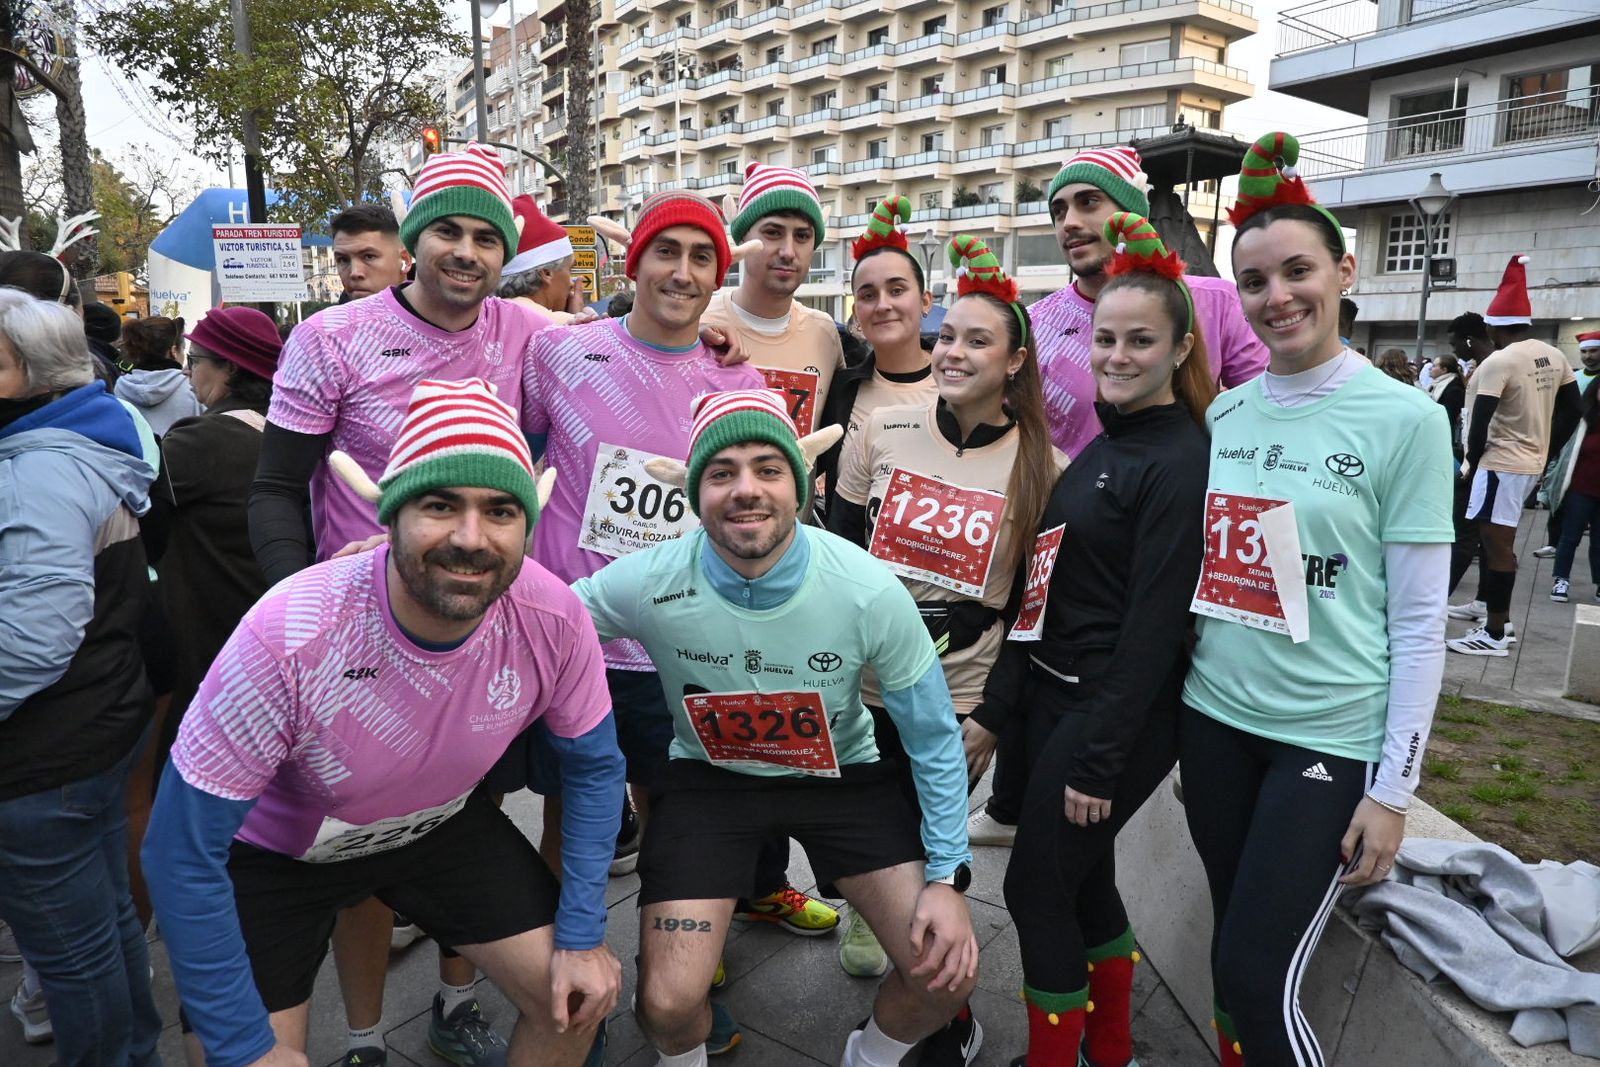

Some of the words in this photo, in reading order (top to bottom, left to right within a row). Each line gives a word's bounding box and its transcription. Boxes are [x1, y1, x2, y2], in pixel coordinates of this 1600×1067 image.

[216, 230, 243, 238] PARADA
[244, 230, 262, 238] TREN
[219, 242, 244, 251] VIZTOR
[286, 242, 297, 250] S.L.
[150, 290, 187, 301] Huelva
[382, 348, 410, 357] 42K
[584, 353, 610, 362] 42K
[1534, 356, 1550, 368] RUN
[884, 422, 910, 430] luanvi
[1216, 447, 1256, 460] Huelva
[1278, 462, 1308, 472] HUELVA
[1312, 478, 1359, 498] HUELVA
[610, 476, 686, 522] 306
[1214, 496, 1228, 506] 5K
[892, 490, 993, 546] 1236
[632, 520, 658, 529] CARLOS
[600, 522, 640, 540] ROVIRA
[922, 535, 944, 546] ELENA
[895, 536, 940, 554] RODRIGUEZ
[941, 548, 967, 562] PEREZ
[1248, 568, 1274, 579] TATIANA
[1214, 572, 1256, 587] BEDARONA
[1258, 581, 1270, 591] DE
[653, 590, 685, 606] luanvi
[676, 648, 728, 666] Huelva
[344, 668, 379, 680] 42K
[763, 667, 794, 676] HUELVA
[804, 676, 844, 688] HUELVA
[701, 706, 821, 742] 1326
[762, 748, 814, 756] RODRIGUEZ
[1302, 770, 1333, 782] adidas
[335, 814, 445, 852] 226
[652, 916, 712, 932] 1992
